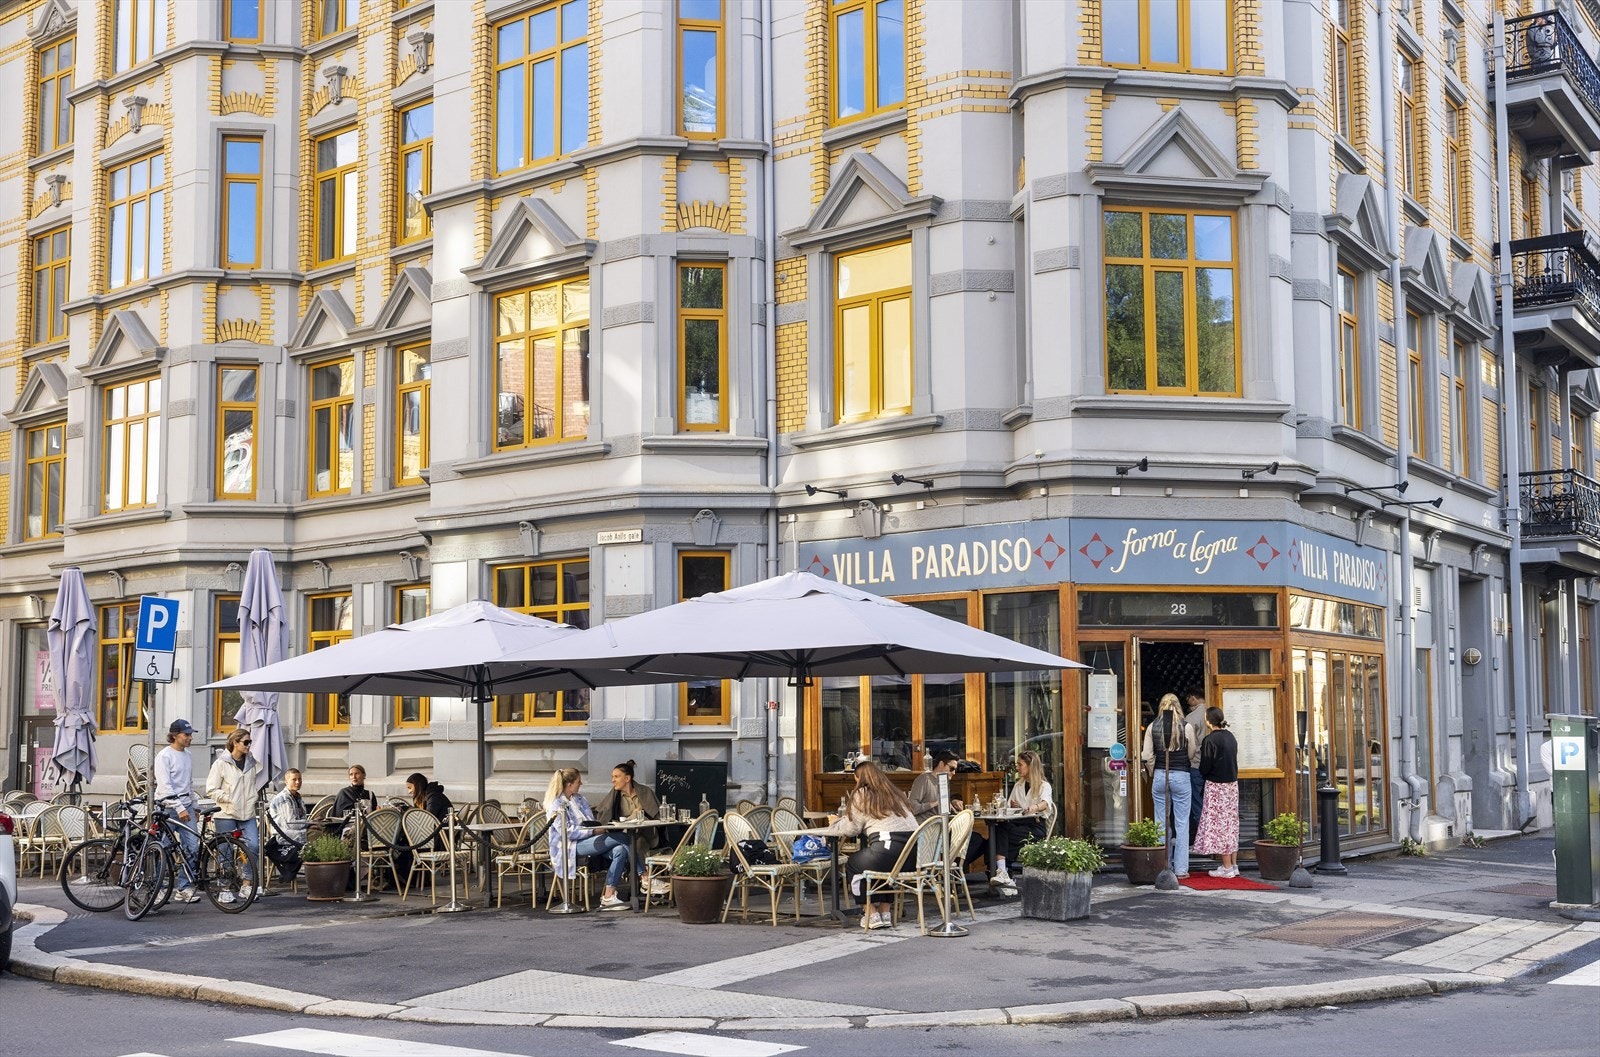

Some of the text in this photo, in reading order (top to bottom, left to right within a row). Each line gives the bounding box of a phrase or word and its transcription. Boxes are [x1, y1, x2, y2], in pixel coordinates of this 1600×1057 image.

[832, 537, 1033, 585] VILLA PARADISO
[1110, 527, 1238, 574] forno a legna
[1300, 540, 1377, 592] VILLA PARADISO
[147, 604, 168, 642] P
[1170, 603, 1187, 616] 28
[1561, 742, 1579, 764] P
[39, 757, 55, 781] 1/2
[41, 783, 53, 791] PRIS
